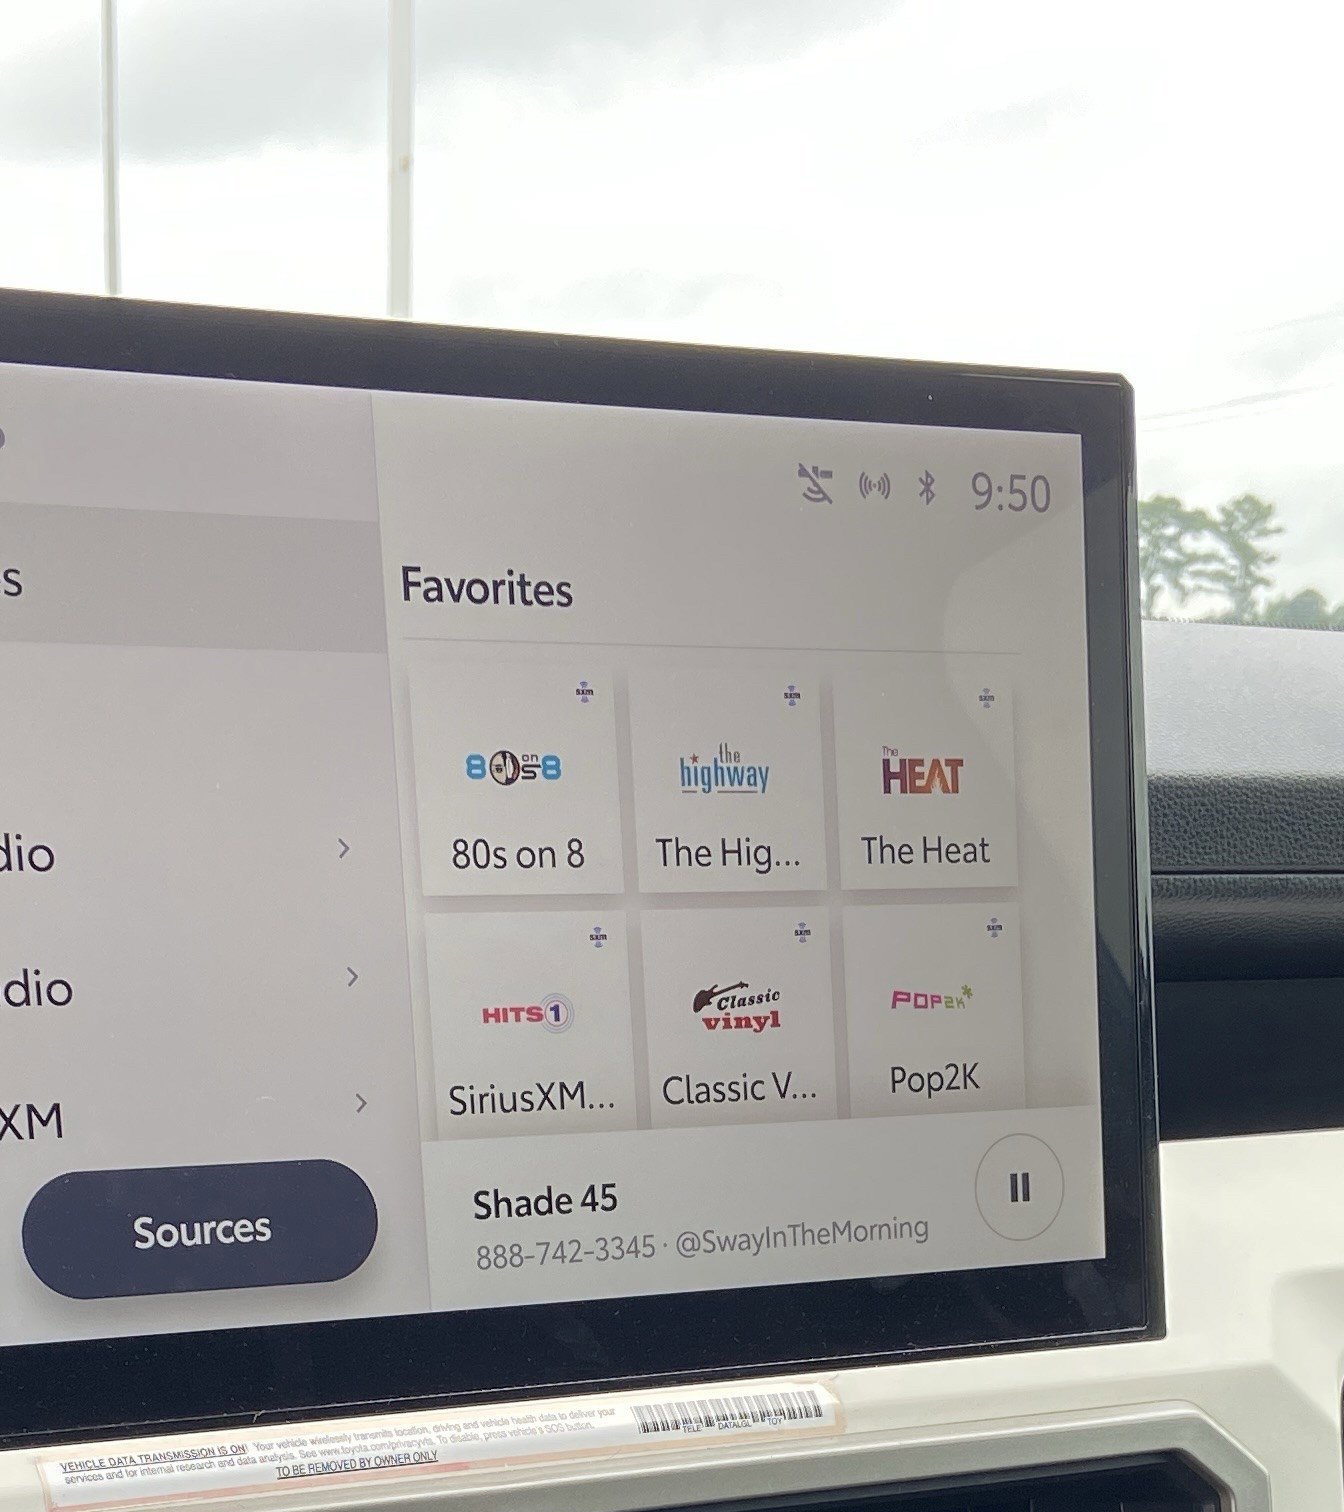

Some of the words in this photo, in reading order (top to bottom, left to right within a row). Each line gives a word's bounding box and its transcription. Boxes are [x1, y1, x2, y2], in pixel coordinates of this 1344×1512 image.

[971, 472, 1051, 513] 9:50
[401, 565, 574, 608] Favorites
[719, 742, 741, 763] the
[882, 745, 898, 757] The
[679, 757, 769, 794] highway
[882, 758, 964, 794] HEAT
[452, 838, 507, 869] 80s
[516, 845, 557, 868] on
[567, 838, 585, 868] 8
[655, 836, 712, 867] The
[721, 836, 800, 874] Hig...
[861, 835, 914, 864] The
[922, 835, 991, 864] Heat
[483, 1006, 544, 1024] HITS
[549, 1003, 561, 1023] 1
[716, 988, 781, 1011] Classic
[702, 1011, 781, 1034] vinyl
[449, 1080, 615, 1116] SiriusXM...
[662, 1072, 766, 1105] Classic
[771, 1071, 817, 1099] V...
[891, 1062, 981, 1098] Pop2K
[472, 1187, 574, 1221] Shade
[579, 1183, 619, 1213] 45
[132, 1214, 273, 1250] Sources
[476, 1234, 656, 1271] 888-742-3345
[676, 1217, 929, 1260] @SwayInTheMorning
[59, 1459, 105, 1472] VEHICLE
[108, 1455, 136, 1467] DATA
[137, 1447, 215, 1463] TRANSMISSION
[217, 1446, 228, 1456] IS
[252, 1441, 274, 1452] Your
[276, 1438, 307, 1449] vehicle
[353, 1429, 394, 1441] transmits
[462, 1420, 479, 1430] and
[480, 1417, 510, 1428] vehicle
[511, 1415, 536, 1425] health
[538, 1413, 557, 1422] data
[558, 1411, 567, 1420] to
[568, 1409, 596, 1419] deliver
[597, 1408, 616, 1418] your
[682, 1424, 702, 1433] TELE
[767, 1417, 782, 1426] TOY
[65, 1473, 104, 1485] services
[106, 1469, 124, 1480] and
[125, 1467, 138, 1478] for
[140, 1463, 174, 1477] internal
[176, 1459, 216, 1473] research
[217, 1458, 235, 1468] and
[237, 1455, 257, 1466] data
[298, 1449, 318, 1459] See
[437, 1434, 448, 1444] To
[484, 1430, 508, 1442] press
[544, 1422, 564, 1433] SOS
[275, 1466, 291, 1477] TO
[292, 1464, 306, 1475] BE
[307, 1459, 357, 1473] REMOVED
[359, 1457, 373, 1468] BY
[374, 1453, 411, 1467] OWNER
[413, 1450, 438, 1462] ONLY
